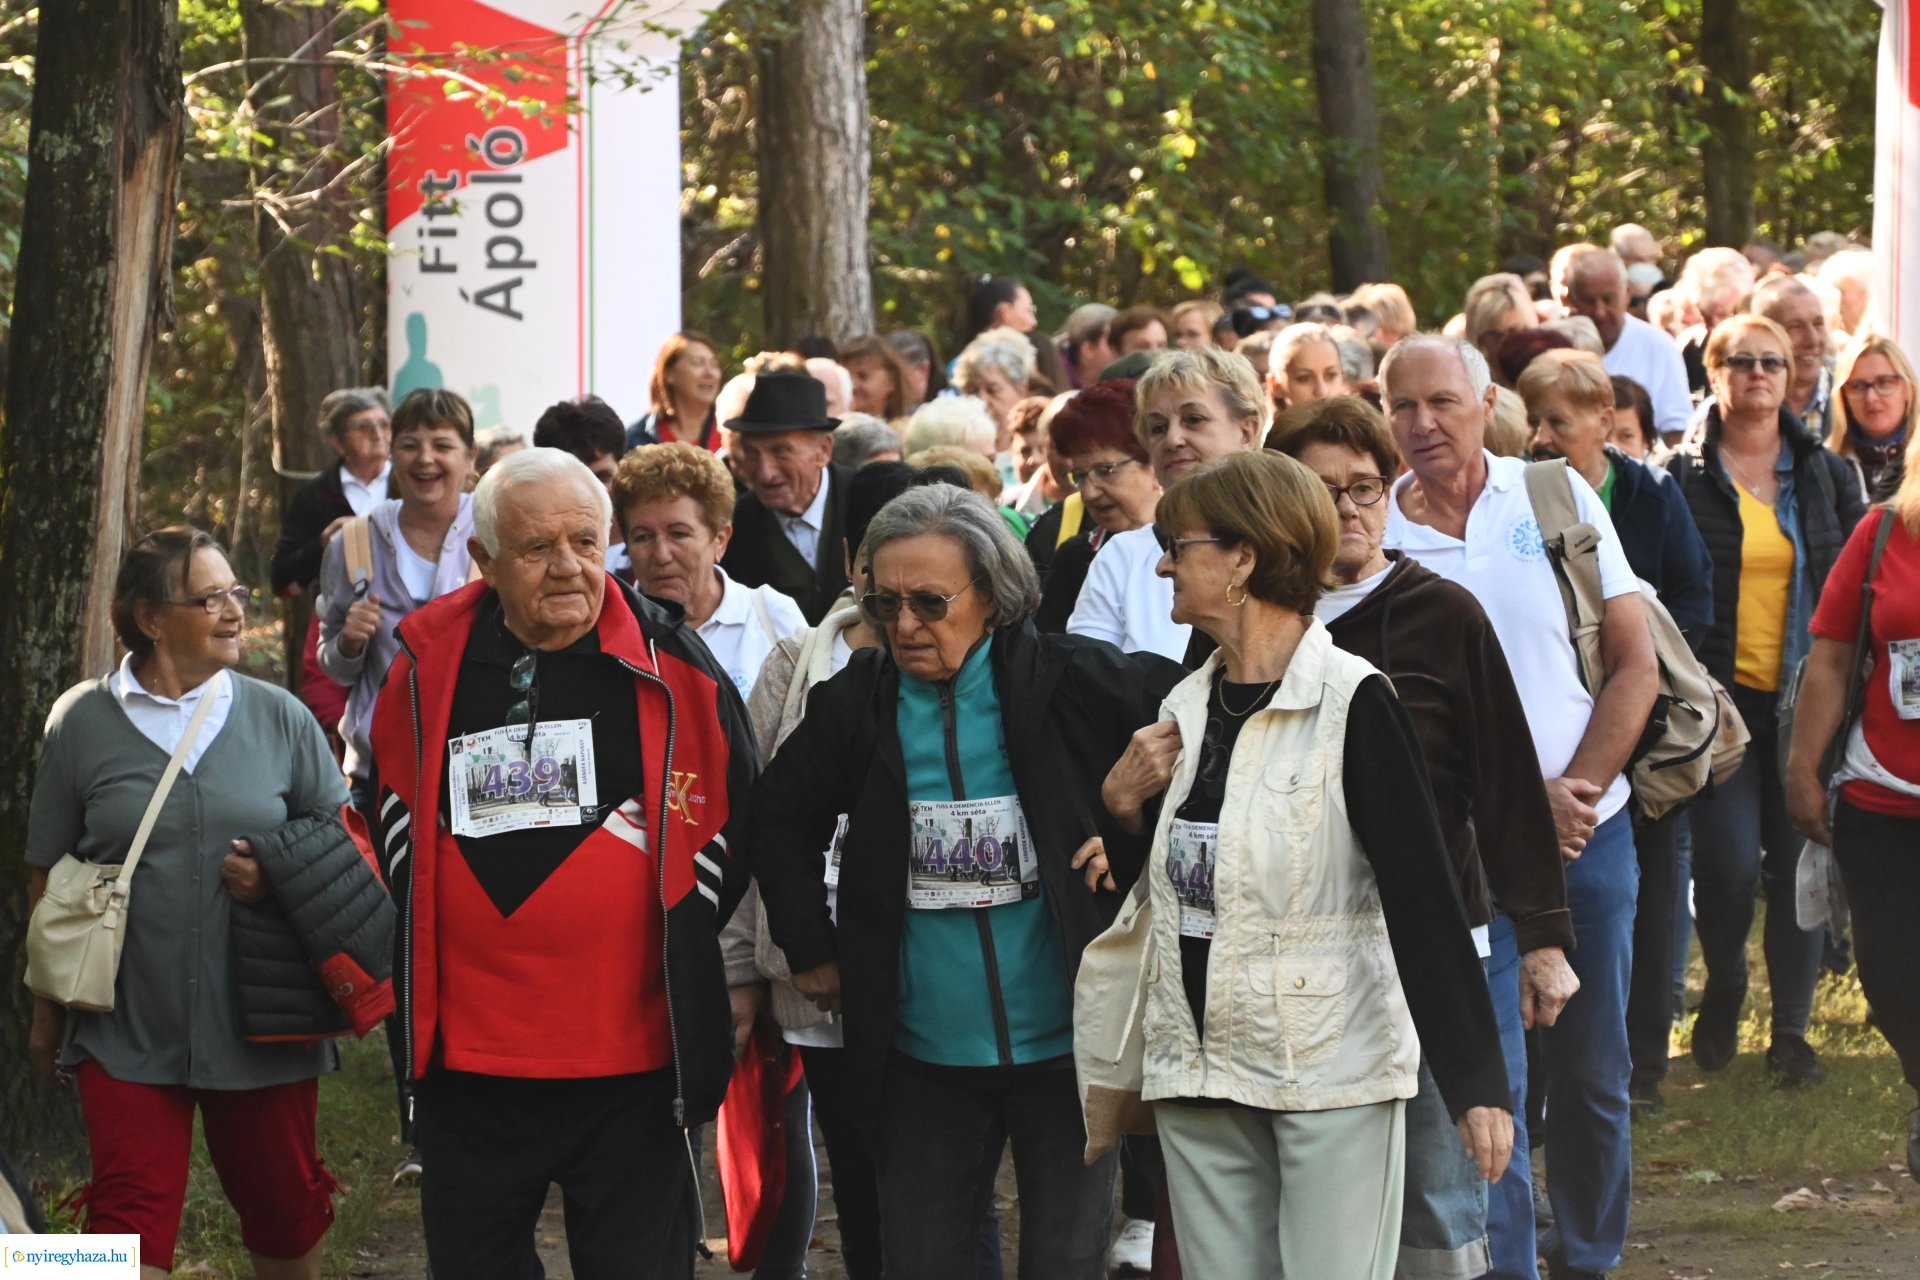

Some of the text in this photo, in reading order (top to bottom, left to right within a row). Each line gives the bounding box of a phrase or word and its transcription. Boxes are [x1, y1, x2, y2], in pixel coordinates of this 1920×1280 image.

[419, 172, 458, 273] Fitt
[459, 128, 537, 321] Ápoló
[477, 735, 491, 743] TKM
[481, 756, 561, 798] 439
[954, 801, 983, 809] DEMENCIA
[923, 834, 1003, 874] 440
[1171, 859, 1215, 900] 44
